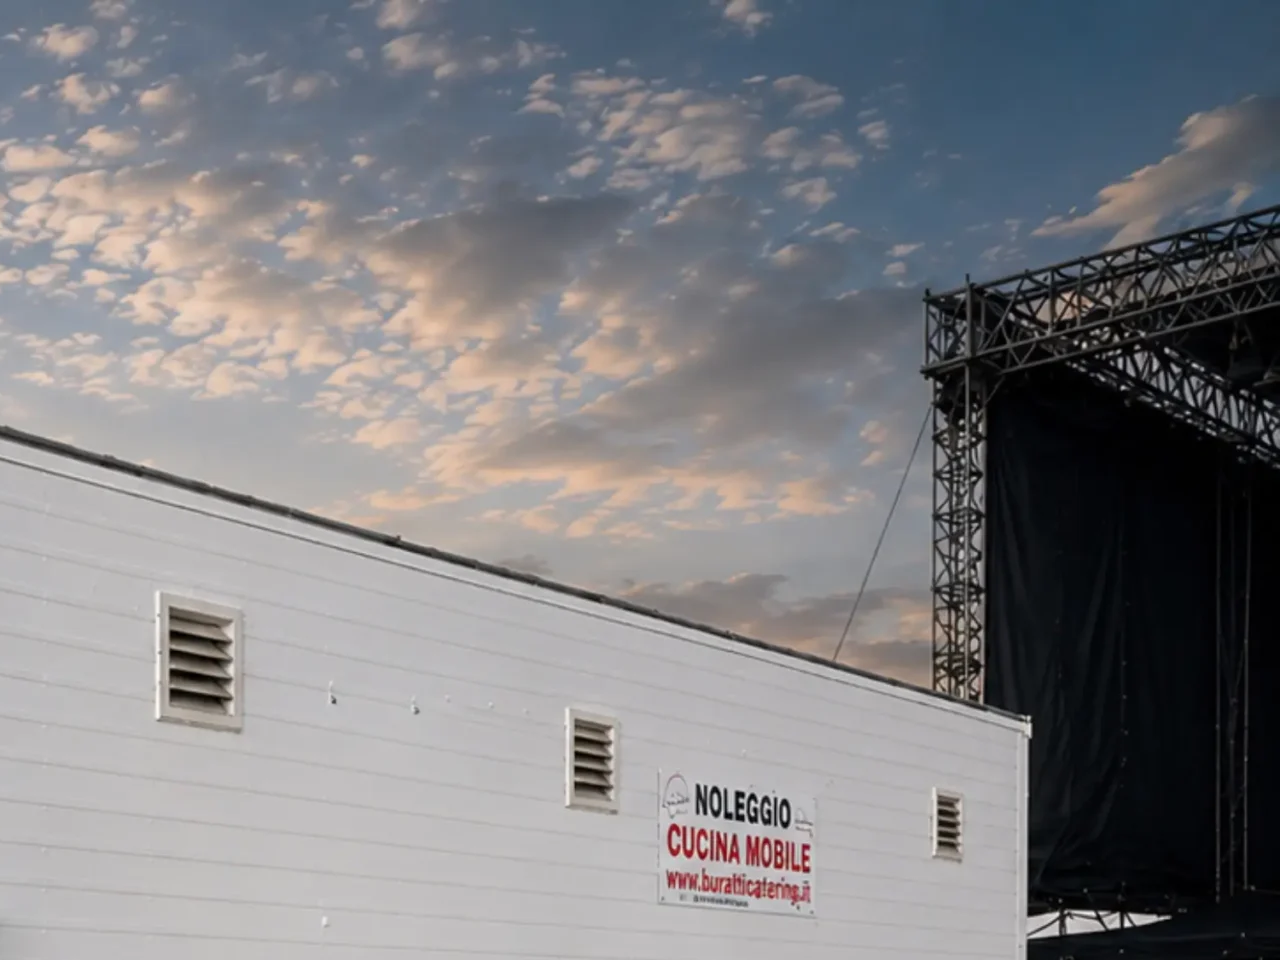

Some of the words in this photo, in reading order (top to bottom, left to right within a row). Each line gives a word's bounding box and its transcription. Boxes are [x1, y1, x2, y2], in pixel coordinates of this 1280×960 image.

[695, 783, 791, 829] NOLEGGIO
[667, 823, 740, 865] CUCINA
[746, 835, 811, 873] MOBILE
